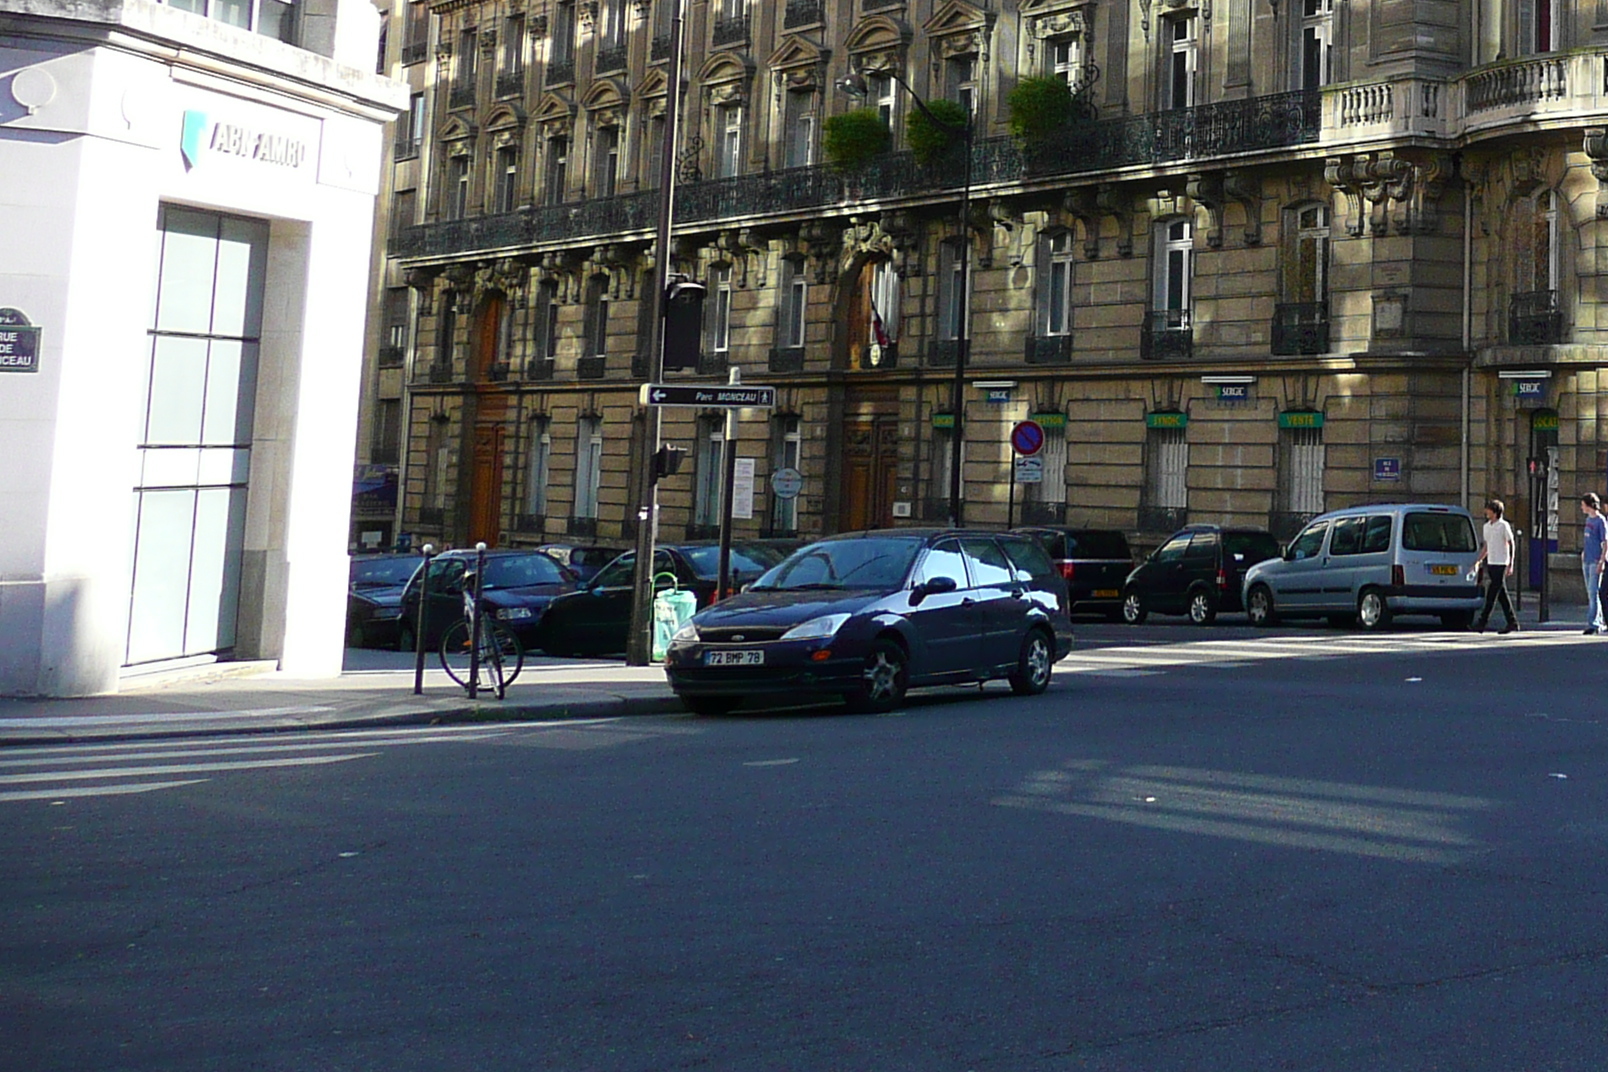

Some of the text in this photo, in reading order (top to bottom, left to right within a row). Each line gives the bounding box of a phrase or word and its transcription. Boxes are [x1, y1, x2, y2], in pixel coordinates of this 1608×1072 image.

[1222, 386, 1244, 396] SERGIC
[711, 652, 760, 663] 72 BMP 78
